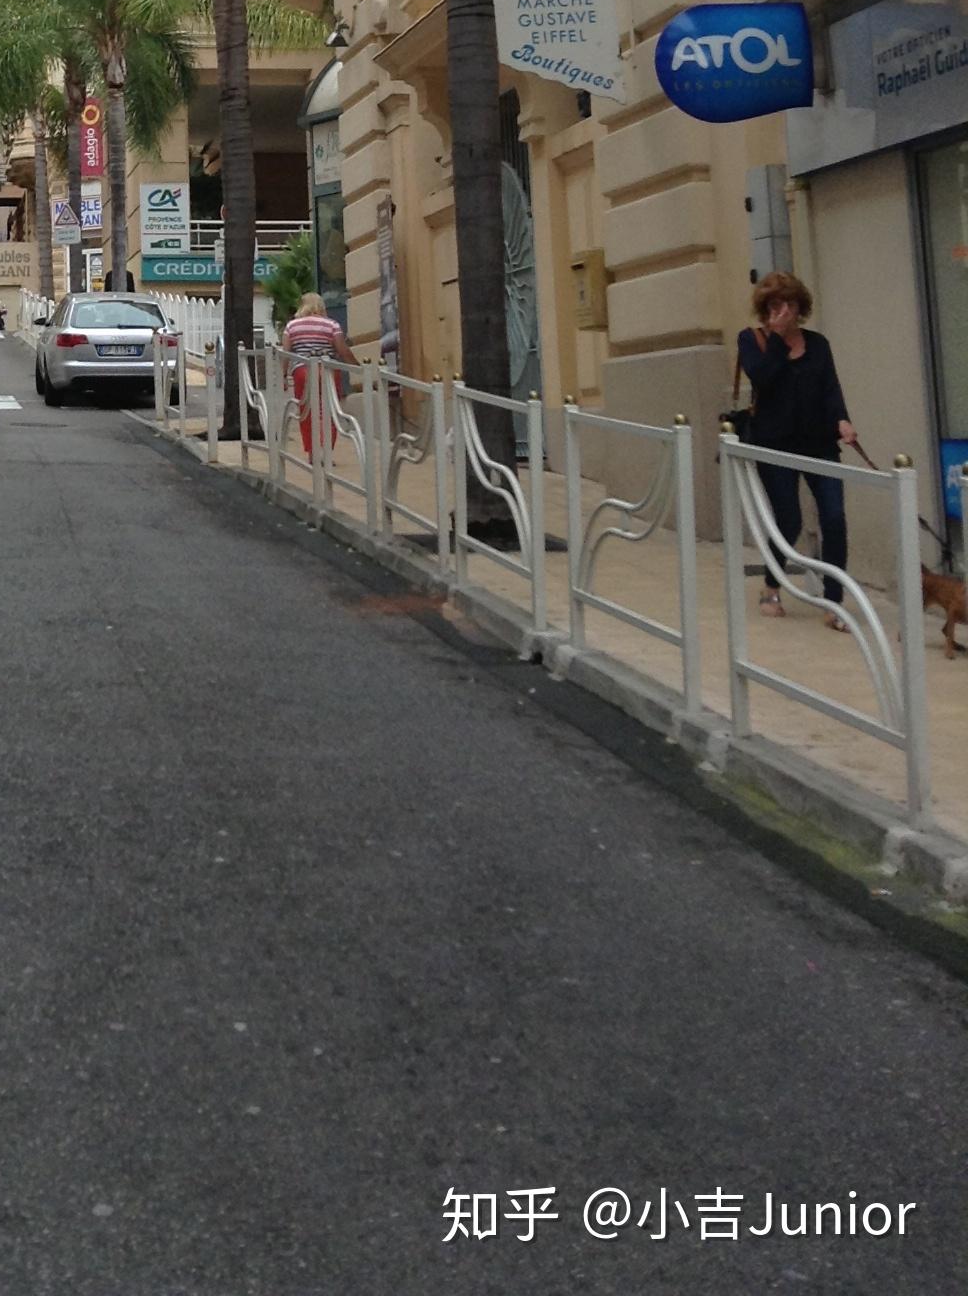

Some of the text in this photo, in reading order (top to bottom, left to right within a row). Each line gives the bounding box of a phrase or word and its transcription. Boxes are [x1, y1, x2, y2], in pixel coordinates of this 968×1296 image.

[518, 10, 598, 28] GUSTAVE
[531, 29, 588, 45] EIFFEL
[511, 44, 615, 90] Boutiques
[671, 27, 802, 74] ATOL
[876, 54, 932, 97] Raphaël
[84, 127, 98, 167] adagio
[153, 260, 221, 276] CRÉDIT
